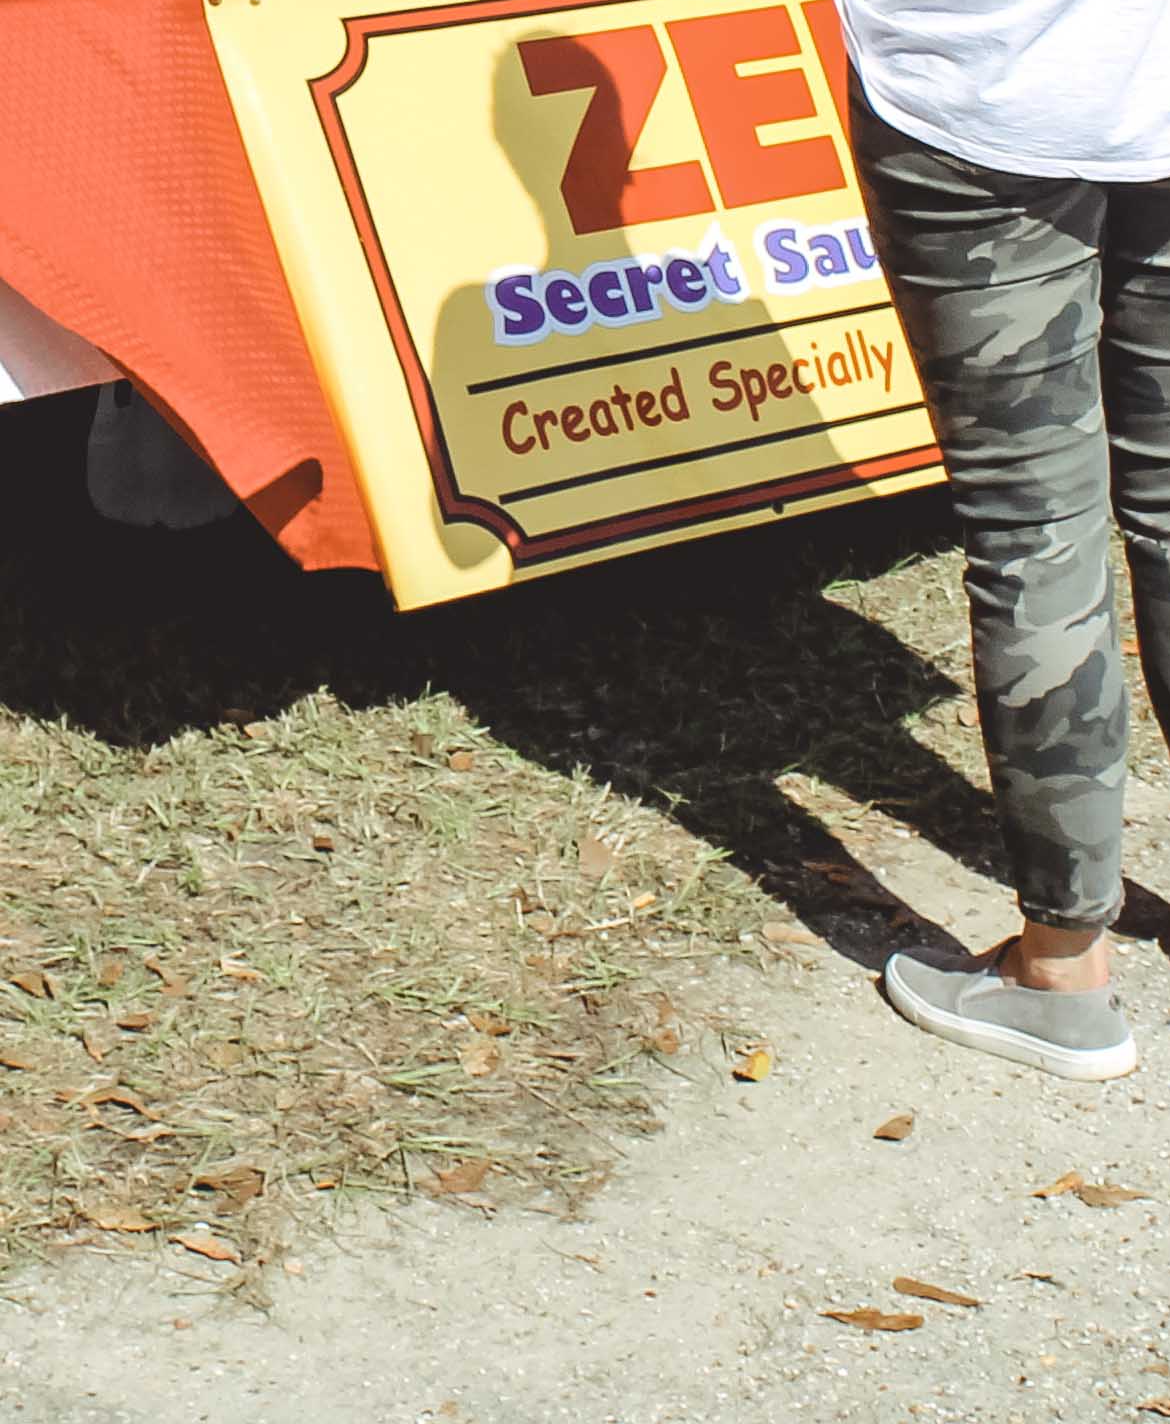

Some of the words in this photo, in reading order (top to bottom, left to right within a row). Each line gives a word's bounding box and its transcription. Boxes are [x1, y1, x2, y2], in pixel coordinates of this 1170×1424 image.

[488, 232, 746, 342] Secret
[502, 367, 690, 455] Created
[709, 329, 893, 421] Specially
